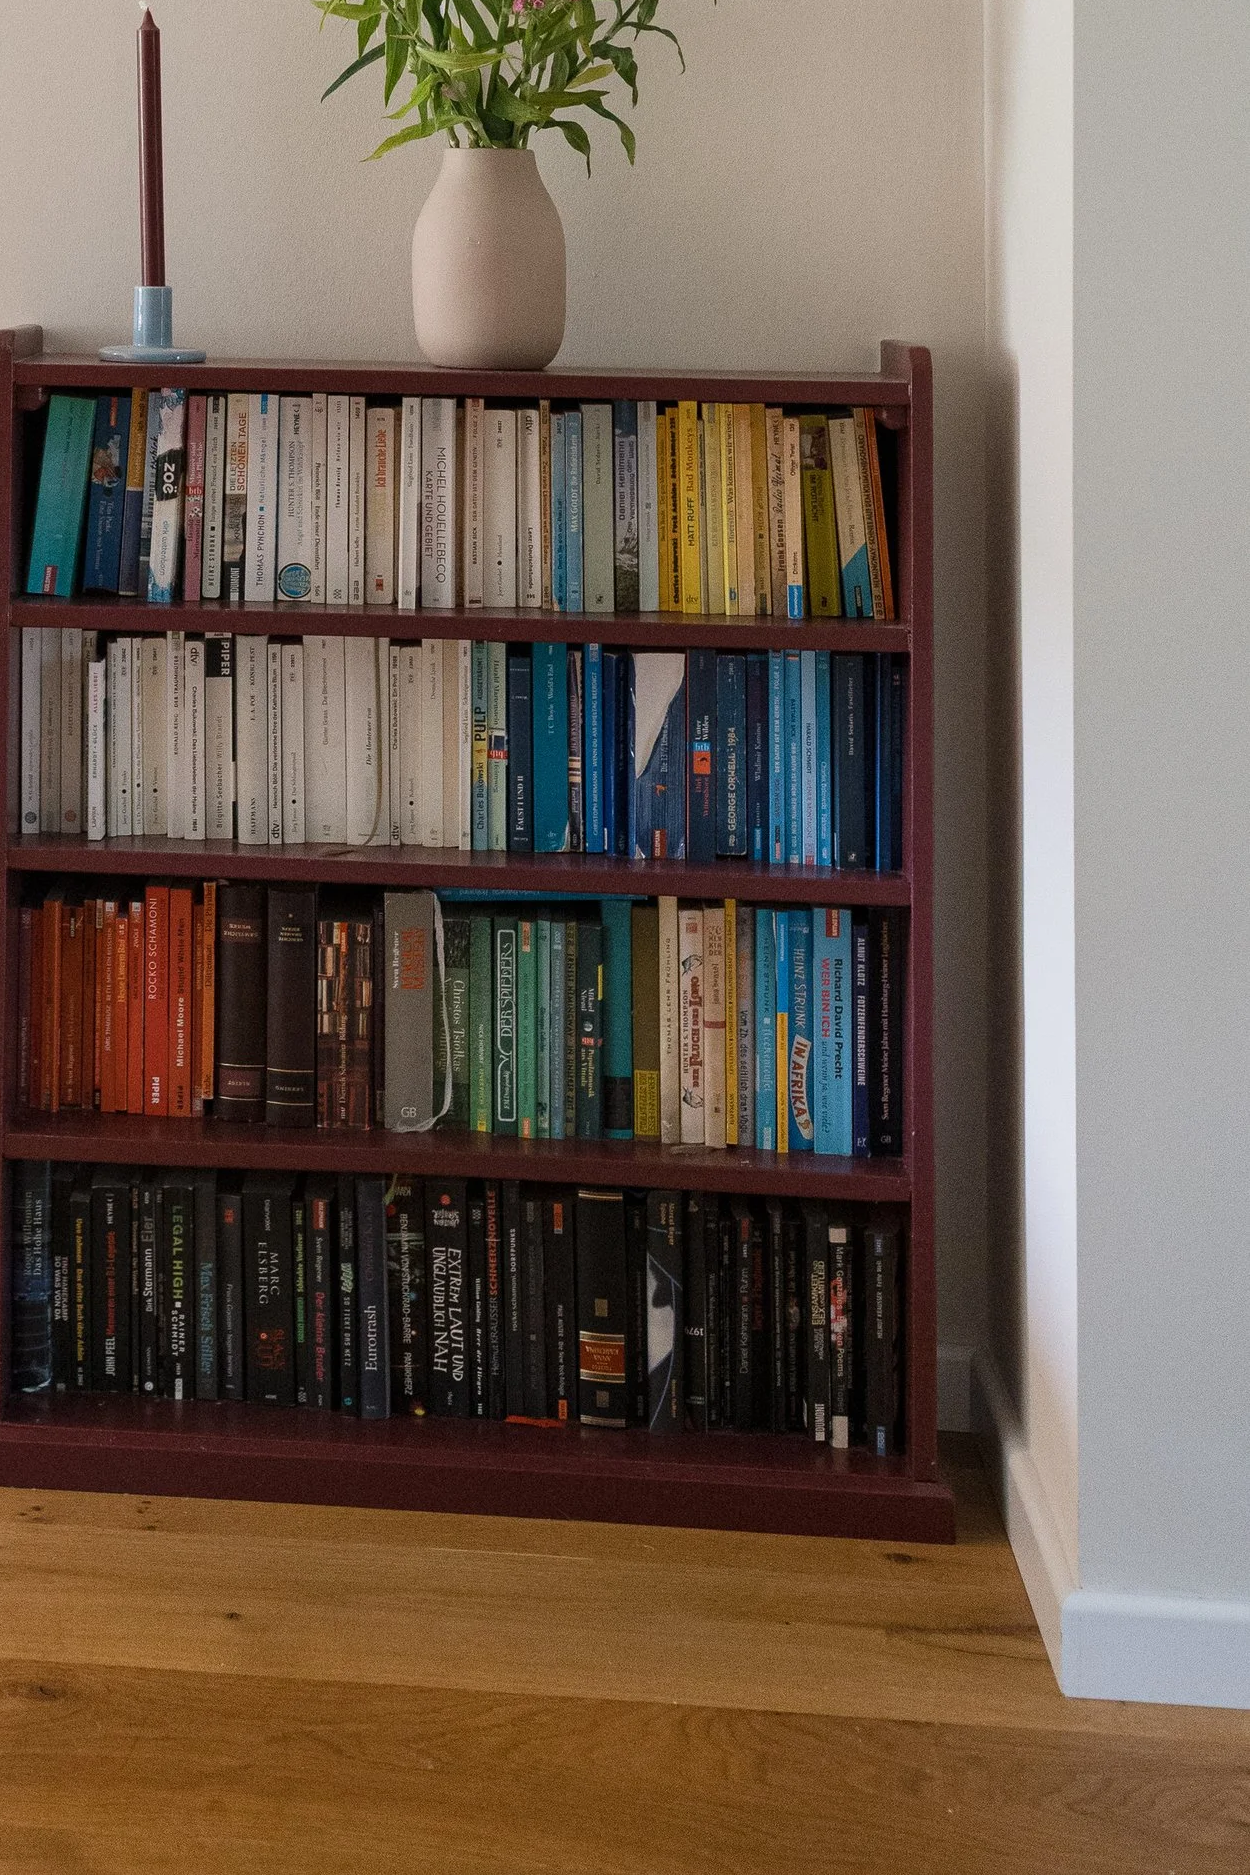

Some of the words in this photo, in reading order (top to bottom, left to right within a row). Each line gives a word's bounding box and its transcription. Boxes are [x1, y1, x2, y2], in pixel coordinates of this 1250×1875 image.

[238, 413, 247, 438] TAGE
[686, 428, 695, 471] Monkeys
[163, 463, 177, 494] zoë
[235, 441, 245, 491] SCHÖNEN
[437, 447, 446, 492] MICHEL
[425, 470, 433, 501] KARTE
[687, 473, 695, 492] Bad
[287, 488, 295, 517] HUNTER
[425, 503, 433, 523] UND
[687, 497, 695, 522] RUFF
[256, 514, 265, 551] PYNCHON
[425, 525, 433, 558] GEBIET
[435, 495, 446, 583] HOUELLEBECQ
[687, 524, 695, 546] MATT
[230, 567, 240, 593] DUMONT
[256, 554, 264, 586] THOMAS
[190, 647, 199, 663] dtv
[221, 642, 229, 675] PIPER
[474, 706, 486, 741] PULP
[727, 727, 736, 747] 1984
[476, 762, 485, 798] Bukowski
[727, 753, 735, 790] ORWELL
[476, 800, 485, 830] Charles
[728, 792, 736, 831] GEORGE
[272, 823, 281, 839] dtv
[392, 825, 400, 840] dtv
[148, 897, 158, 957] SCHAMONI
[177, 918, 185, 937] Men
[177, 939, 185, 963] White
[793, 948, 806, 981] HEINZ
[857, 938, 866, 962] ALMUT
[147, 961, 157, 1000] ROCKO
[392, 970, 400, 989] Sven
[821, 957, 830, 986] WER
[834, 958, 843, 1002] Richard
[857, 965, 866, 986] KLOTZ
[452, 980, 465, 1025] Christos
[689, 976, 702, 1007] LONO
[793, 984, 807, 1027] STRUNK
[821, 990, 830, 1012] BIN
[500, 1017, 513, 1037] DER
[821, 1015, 830, 1038] ICH
[834, 1006, 843, 1039] David
[881, 1018, 889, 1030] mit
[176, 1029, 185, 1067] Michael
[452, 1028, 465, 1072] Tsiolkas
[689, 1028, 703, 1067] FLUCH
[793, 1041, 808, 1057] IN
[821, 1041, 830, 1057] und
[857, 995, 866, 1086] FOTZENFENDERSCHWEINE
[881, 1032, 889, 1049] Jahre
[821, 1058, 829, 1079] wenn
[834, 1042, 843, 1079] Precht
[881, 1051, 889, 1072] Meine
[692, 1068, 700, 1088] DER
[791, 1061, 807, 1117] AFRIKA
[881, 1074, 890, 1102] Regener
[401, 1107, 417, 1118] GB
[881, 1104, 889, 1120] Sven
[23, 1191, 33, 1244] Willemsen
[33, 1199, 42, 1225] Haus
[33, 1228, 42, 1254] Hohe
[142, 1216, 153, 1242] Eier
[173, 1205, 183, 1255] LEGAL
[399, 1213, 409, 1253] BENJAMIN
[315, 1236, 323, 1254] Sven
[836, 1247, 844, 1268] Mark
[24, 1247, 34, 1276] Roger
[33, 1257, 42, 1276] Das
[55, 1256, 61, 1268] SO
[143, 1248, 153, 1296] Stermann
[258, 1242, 268, 1305] ELSBERG
[270, 1252, 280, 1296] MARC
[400, 1255, 409, 1271] VON
[447, 1248, 462, 1302] EXTREM
[173, 1260, 183, 1299] HIGH
[432, 1247, 446, 1327] UNGLAUBLICH
[739, 1267, 749, 1293] Ruhm
[817, 1261, 825, 1294] MITLEID
[55, 1309, 61, 1320] DA
[145, 1298, 153, 1312] Dirk
[315, 1292, 325, 1310] Der
[401, 1272, 411, 1344] STUCKRAD-BARRE
[448, 1308, 463, 1351] LAUT
[490, 1296, 499, 1344] KRAUSSER
[740, 1304, 749, 1346] Kehlmann
[818, 1308, 826, 1325] SEX
[106, 1337, 115, 1355] PEEL
[364, 1304, 378, 1371] Eurotrash
[432, 1331, 448, 1373] NAH
[106, 1356, 115, 1376] JOHN
[403, 1352, 413, 1395] PANIKHERZ
[452, 1354, 463, 1382] UND
[491, 1344, 500, 1375] Helmut
[740, 1347, 749, 1374] Daniel
[837, 1348, 845, 1377] Poems
[815, 1403, 825, 1432] DUMONT
